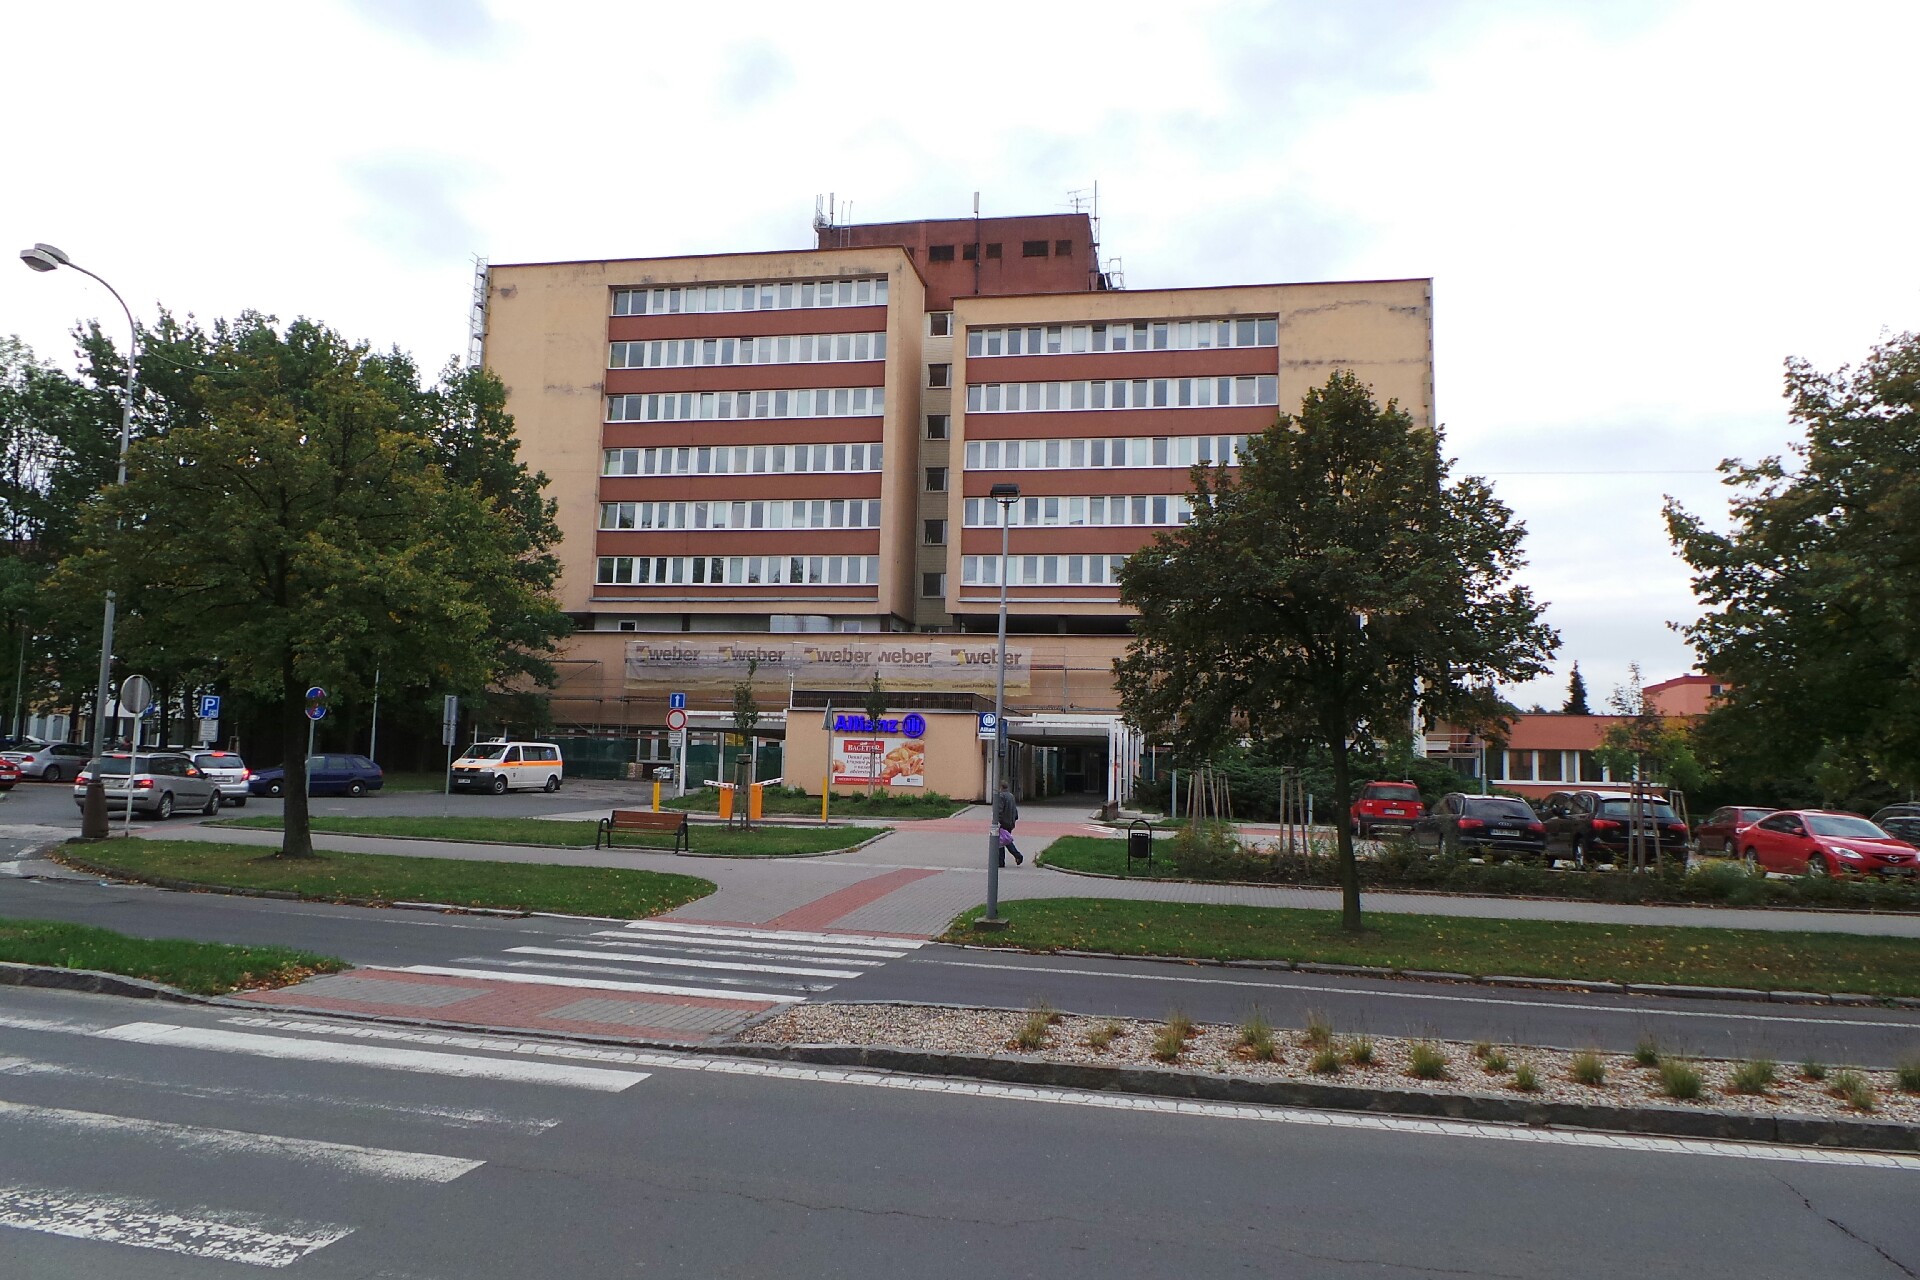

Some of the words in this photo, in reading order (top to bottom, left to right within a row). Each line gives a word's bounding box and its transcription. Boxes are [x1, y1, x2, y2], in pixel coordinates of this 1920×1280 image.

[648, 645, 701, 661] weber
[731, 646, 786, 662] weber
[817, 647, 872, 663] weber
[204, 698, 216, 711] P
